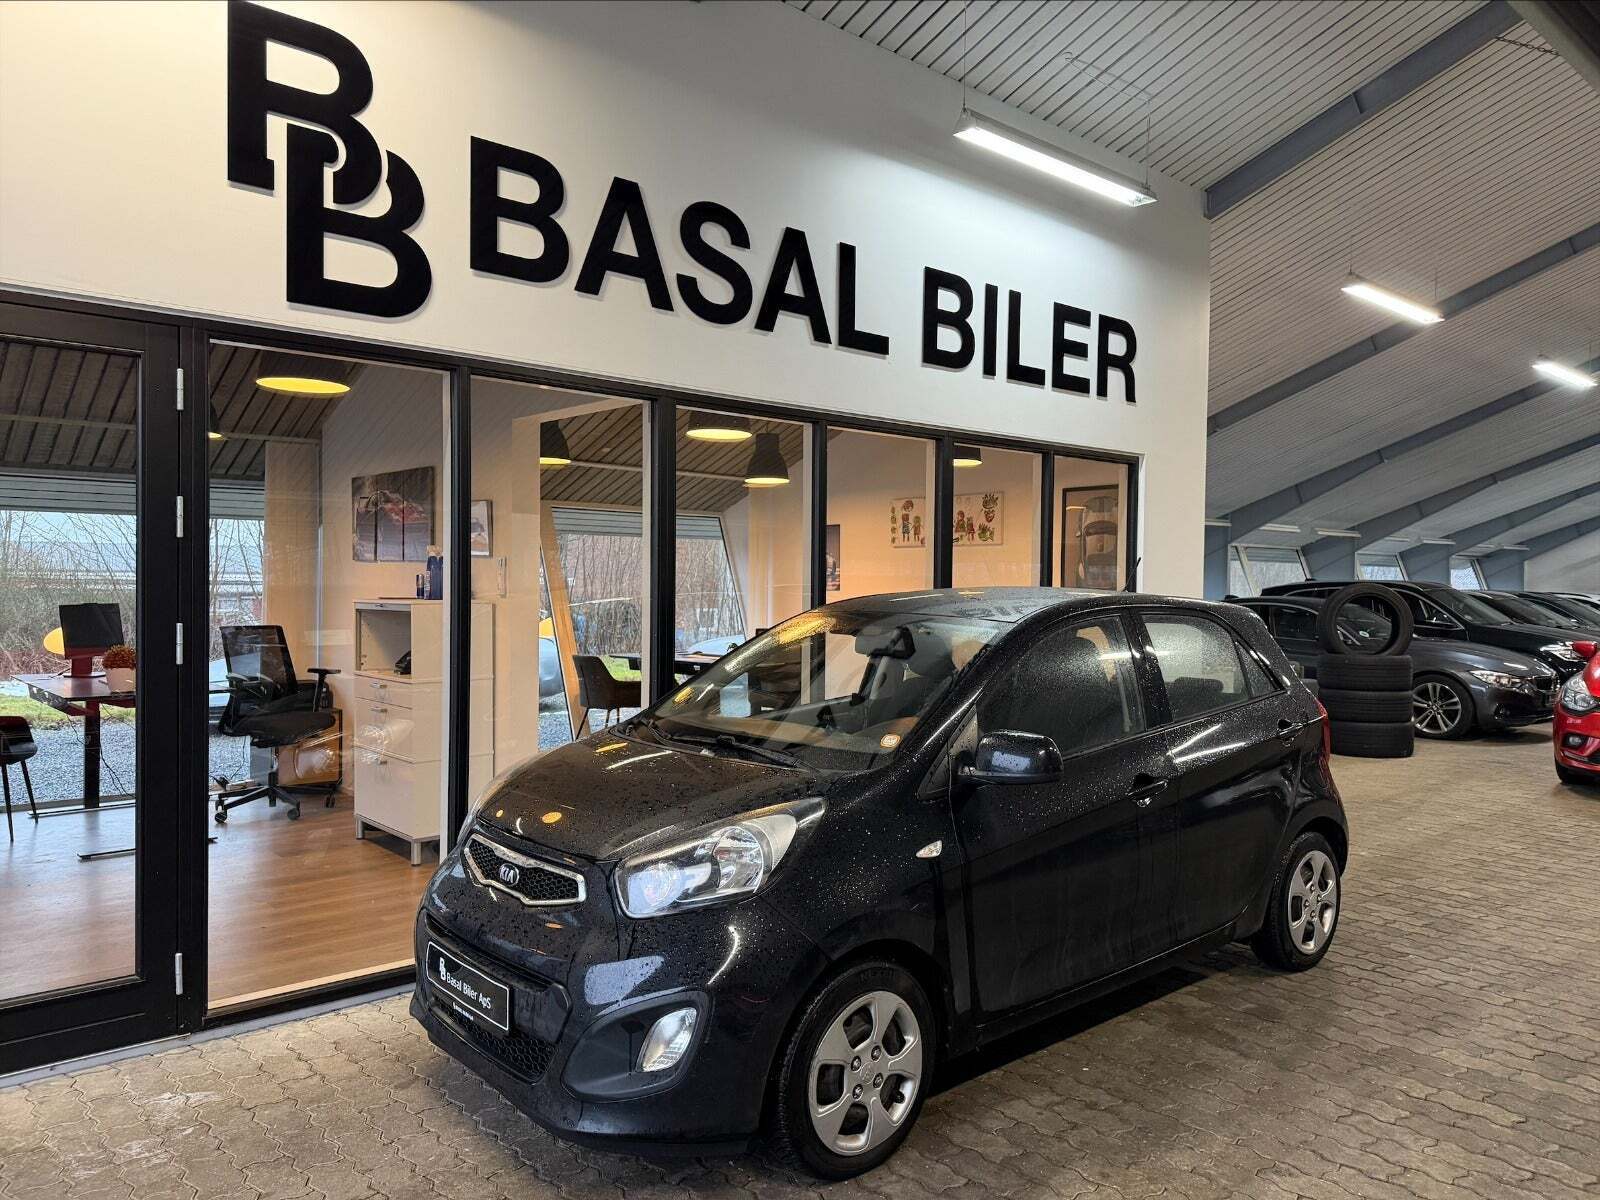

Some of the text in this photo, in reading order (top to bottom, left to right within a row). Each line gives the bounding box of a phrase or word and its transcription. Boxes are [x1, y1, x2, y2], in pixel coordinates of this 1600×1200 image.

[470, 135, 1138, 404] BASAL BILER
[446, 971, 492, 1010] Basal Biler ApS
